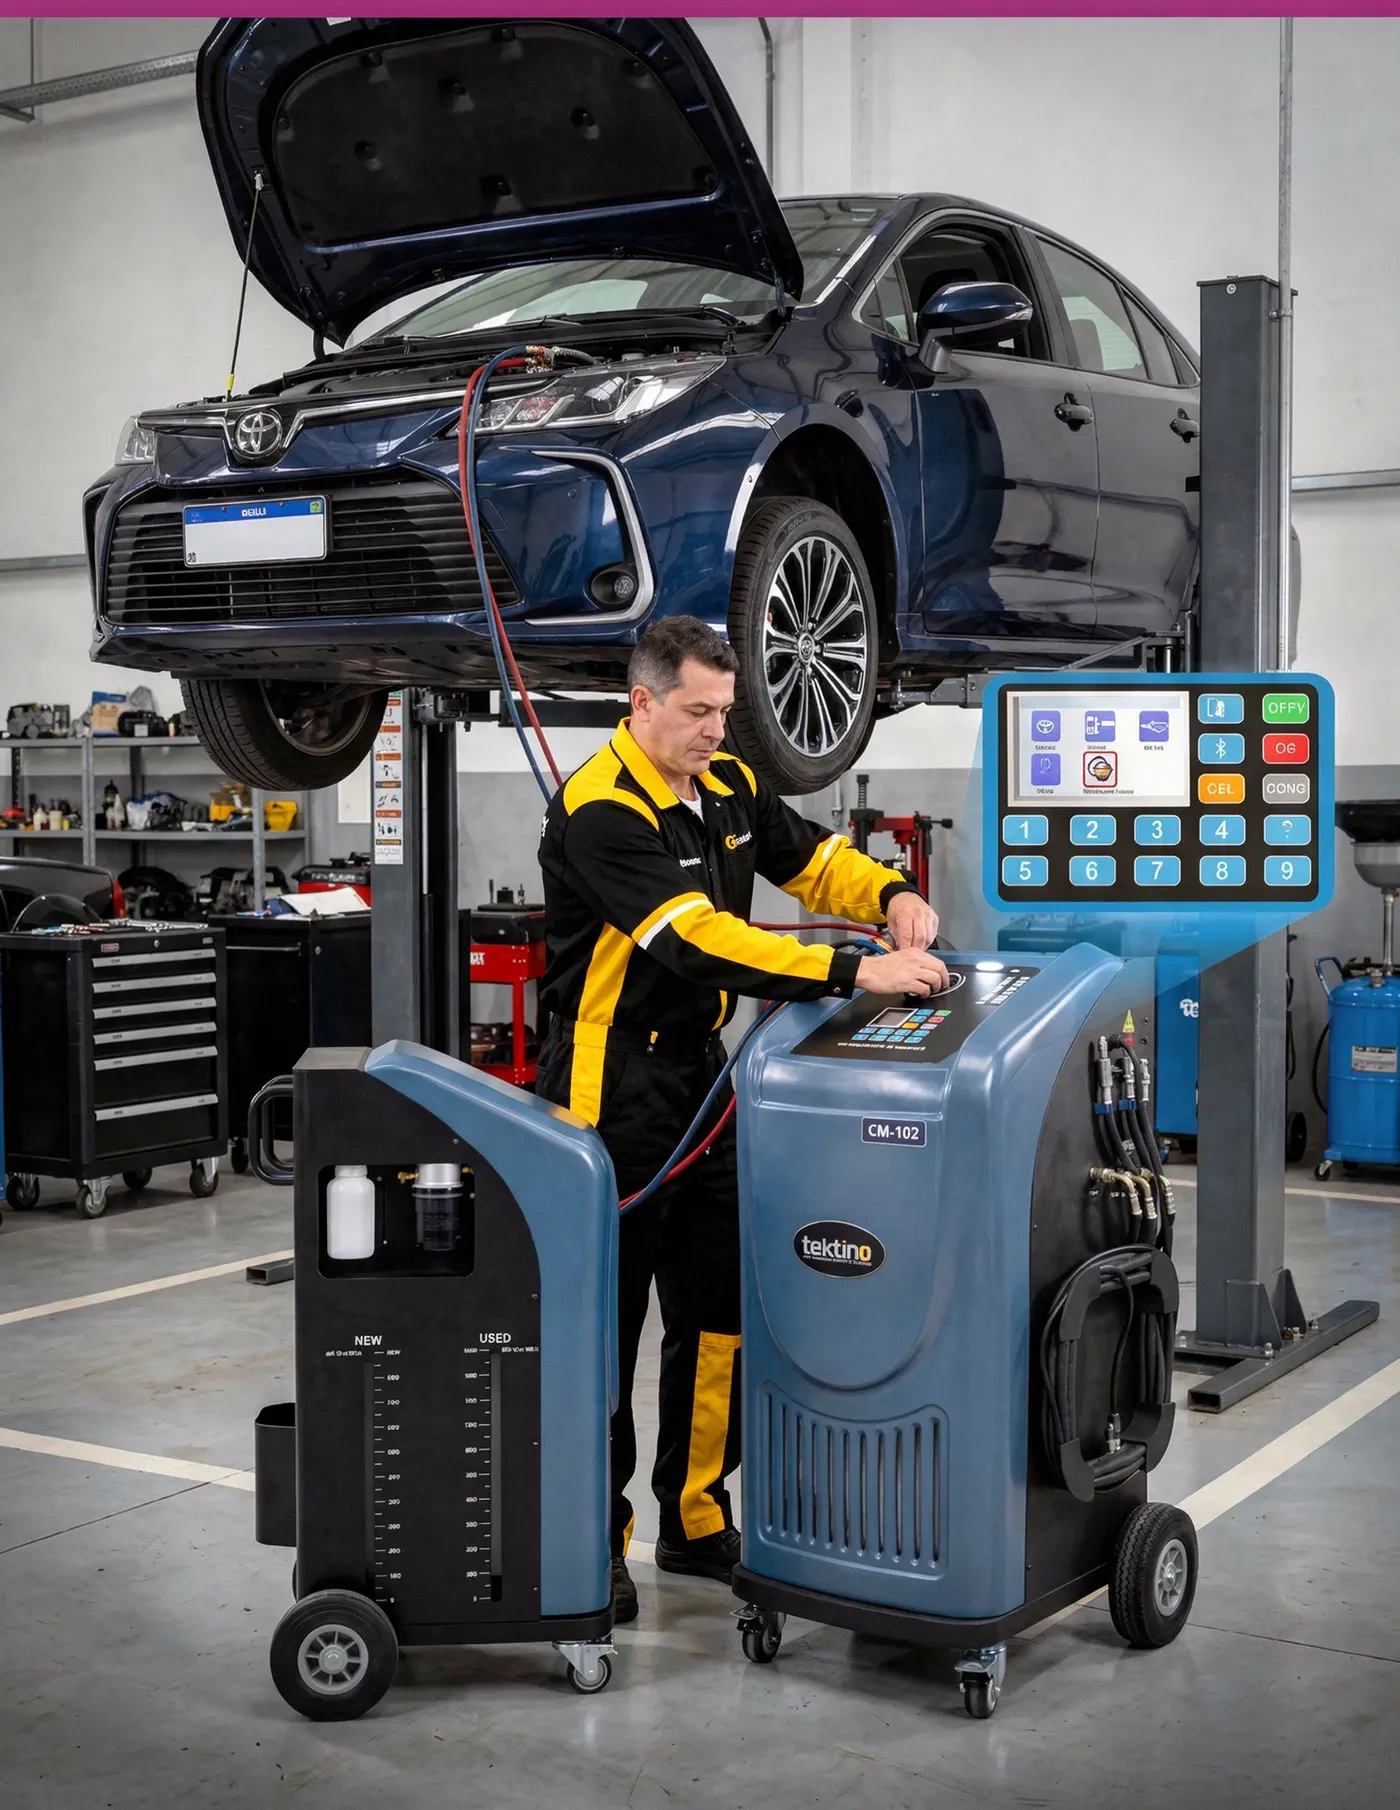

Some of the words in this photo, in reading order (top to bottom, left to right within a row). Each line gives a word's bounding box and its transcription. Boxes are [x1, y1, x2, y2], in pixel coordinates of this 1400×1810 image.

[868, 1124, 919, 1140] CM-102
[802, 1235, 872, 1262] tektino
[354, 1335, 383, 1346] NEW
[479, 1332, 512, 1344] USED
